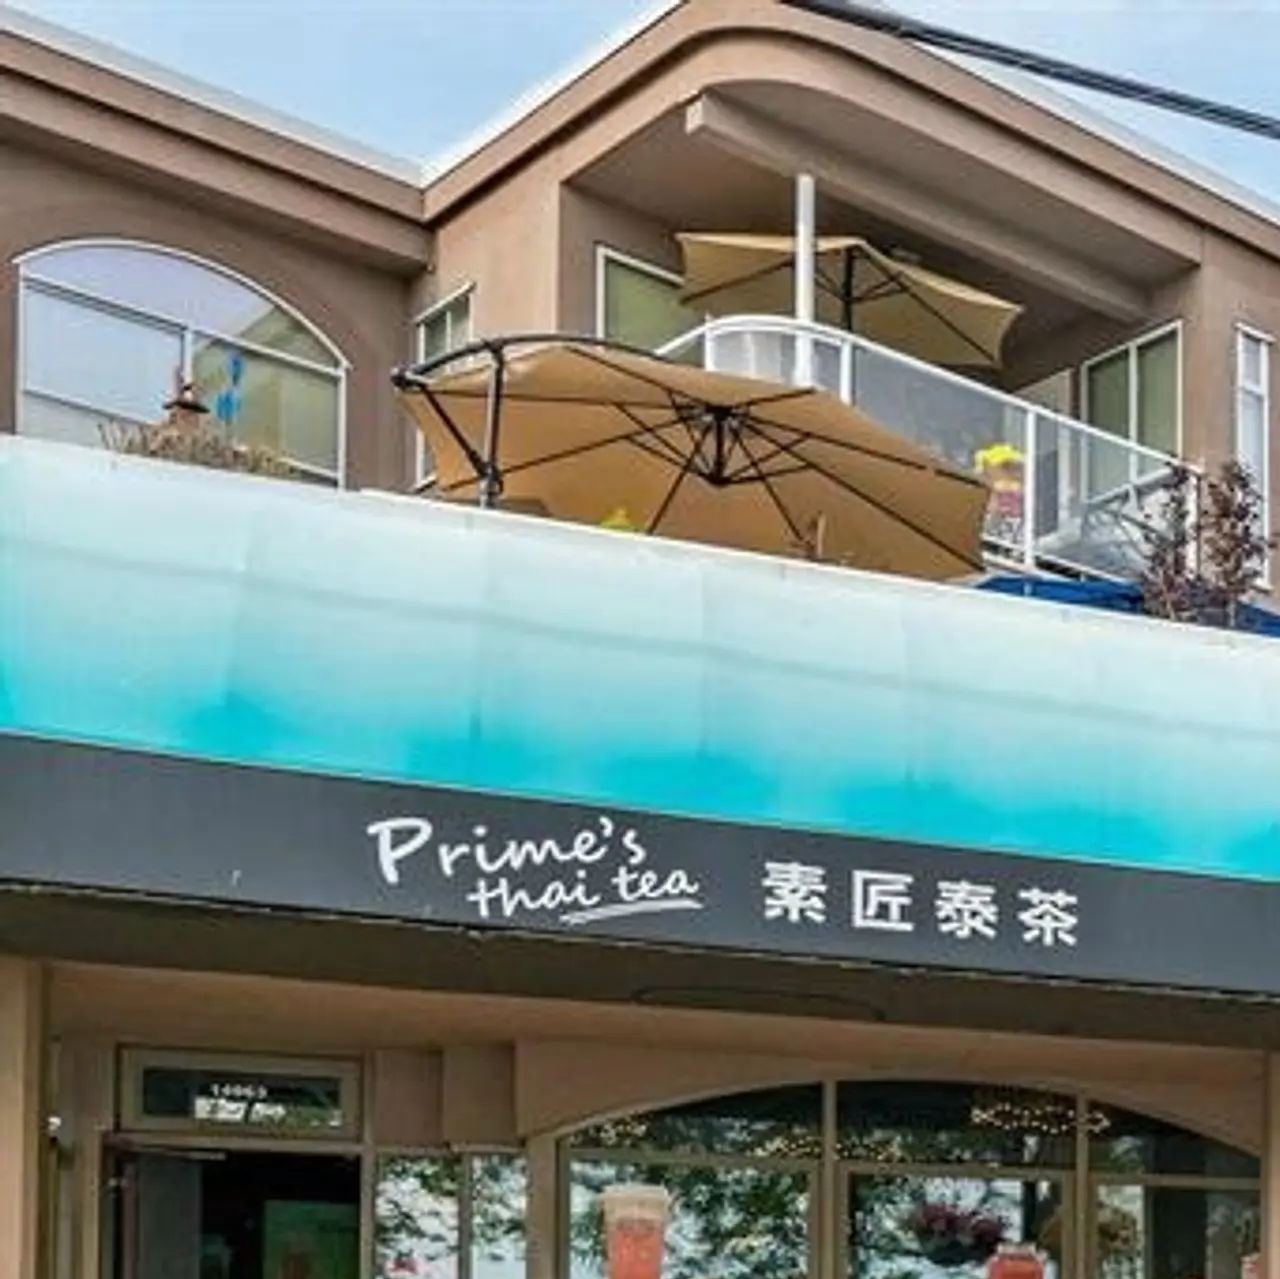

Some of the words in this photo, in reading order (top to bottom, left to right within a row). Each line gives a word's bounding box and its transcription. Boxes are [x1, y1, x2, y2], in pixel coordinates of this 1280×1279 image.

[367, 817, 647, 884] Prime's
[467, 869, 602, 918] thai
[611, 865, 699, 901] tea
[762, 861, 1078, 946] 素匠泰茶
